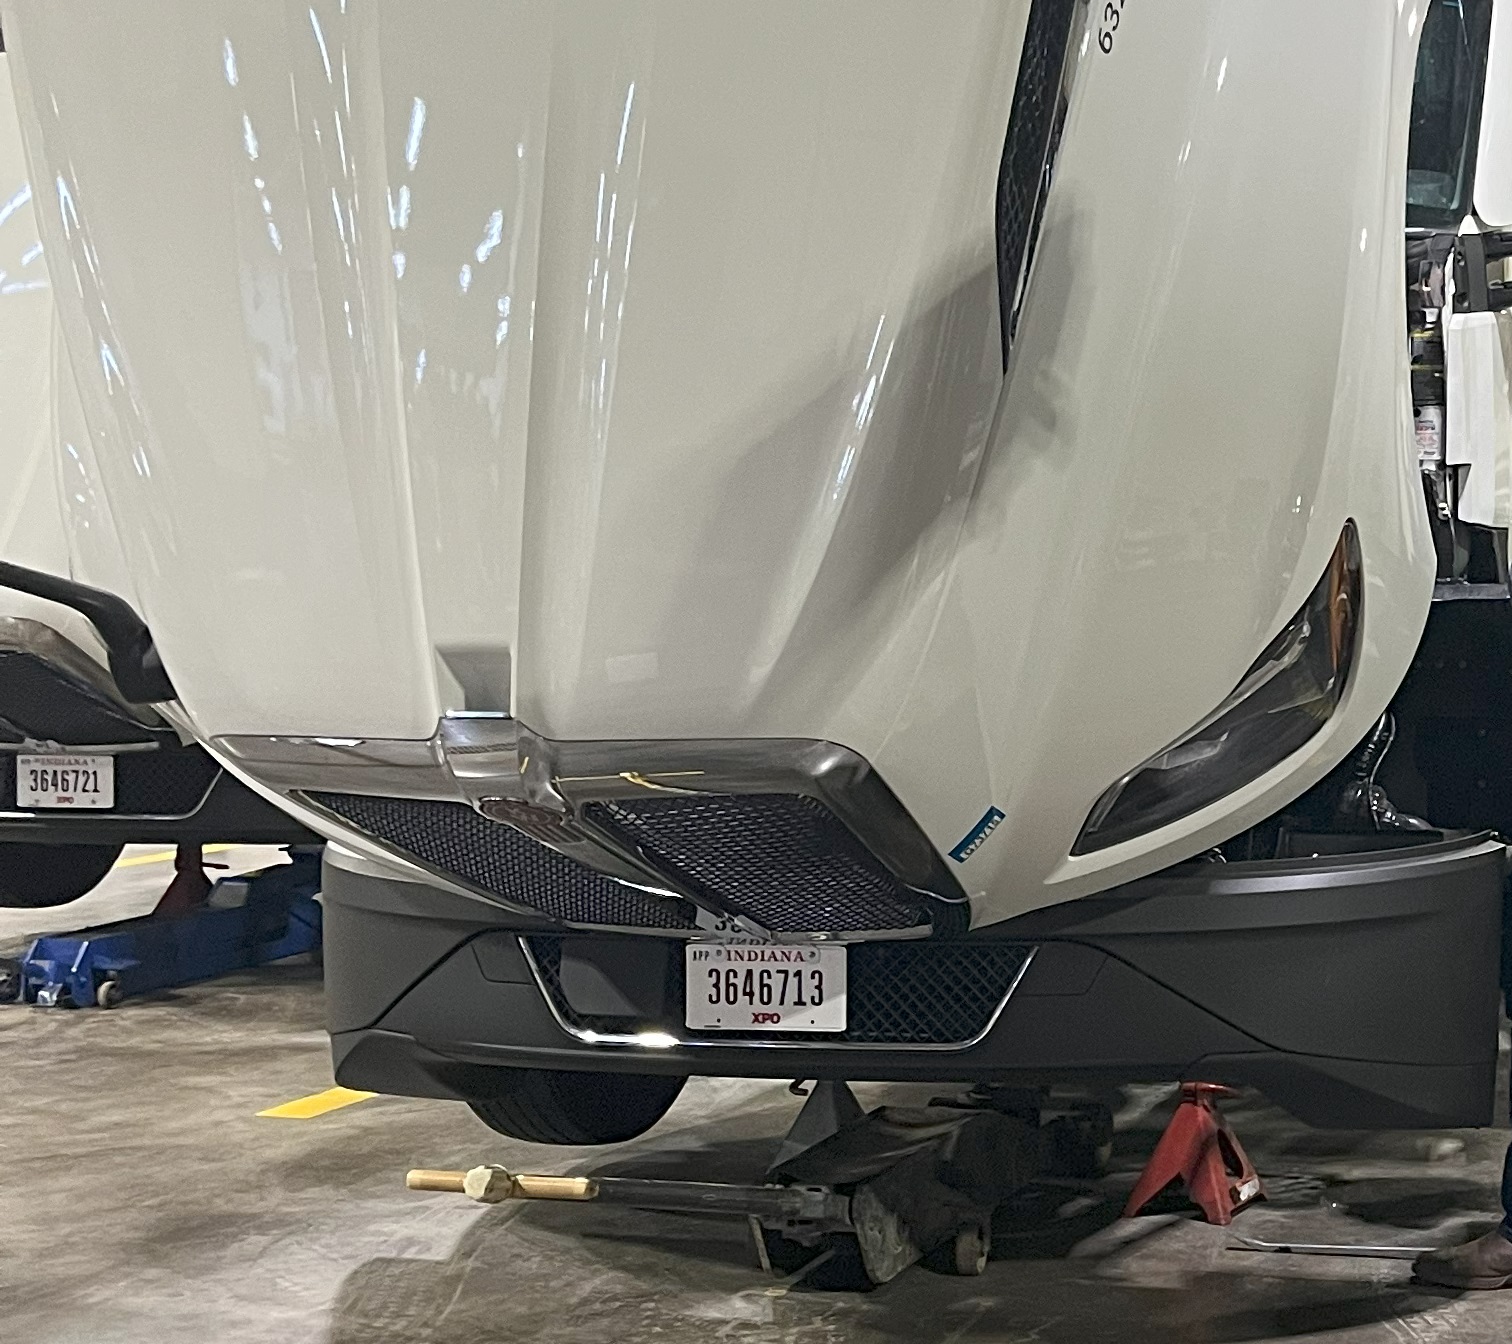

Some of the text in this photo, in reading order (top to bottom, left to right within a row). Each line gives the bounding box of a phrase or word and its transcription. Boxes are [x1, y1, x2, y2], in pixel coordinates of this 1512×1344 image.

[29, 769, 101, 793] 3646721
[726, 950, 806, 963] INDIANA
[708, 968, 824, 1007] 3646713
[752, 1012, 781, 1025] XPO
